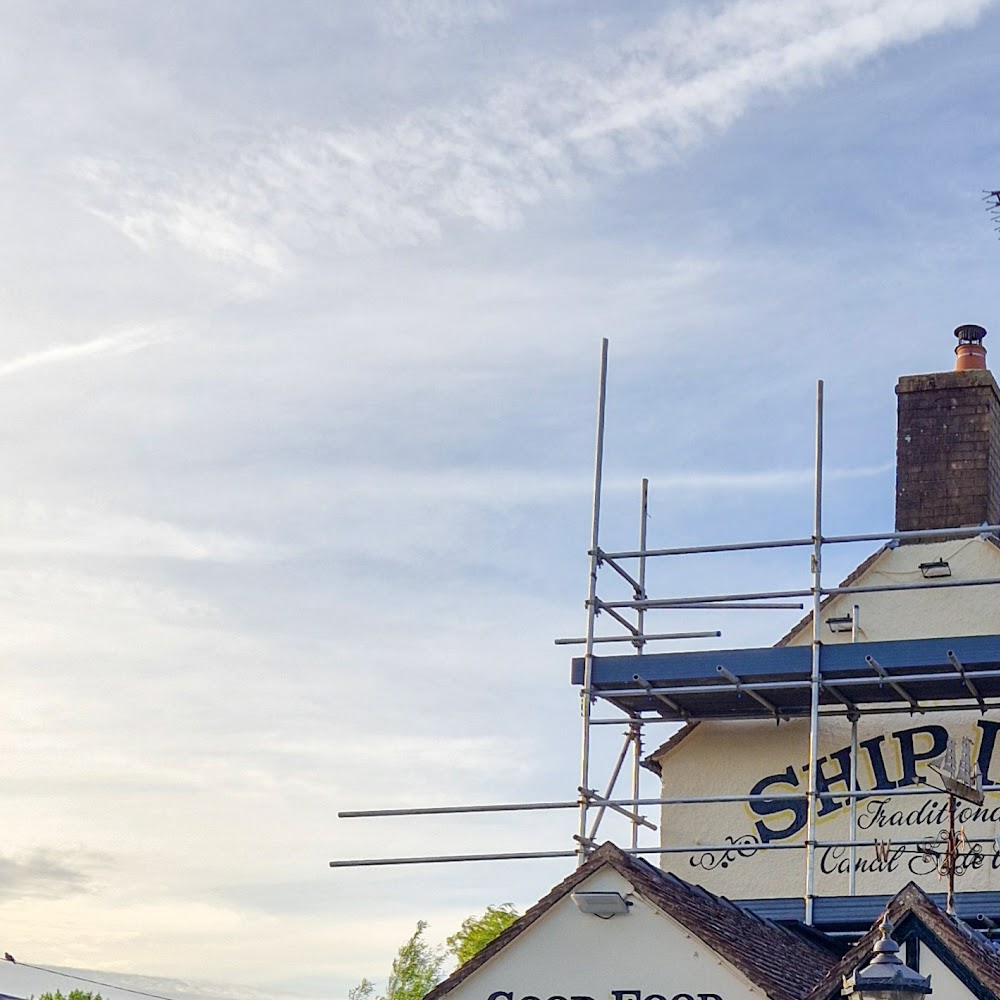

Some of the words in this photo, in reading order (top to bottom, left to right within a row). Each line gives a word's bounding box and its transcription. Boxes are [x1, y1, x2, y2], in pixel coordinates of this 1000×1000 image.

[748, 724, 949, 844] SHIP
[820, 842, 900, 875] Canal
[908, 836, 985, 876] Sde
